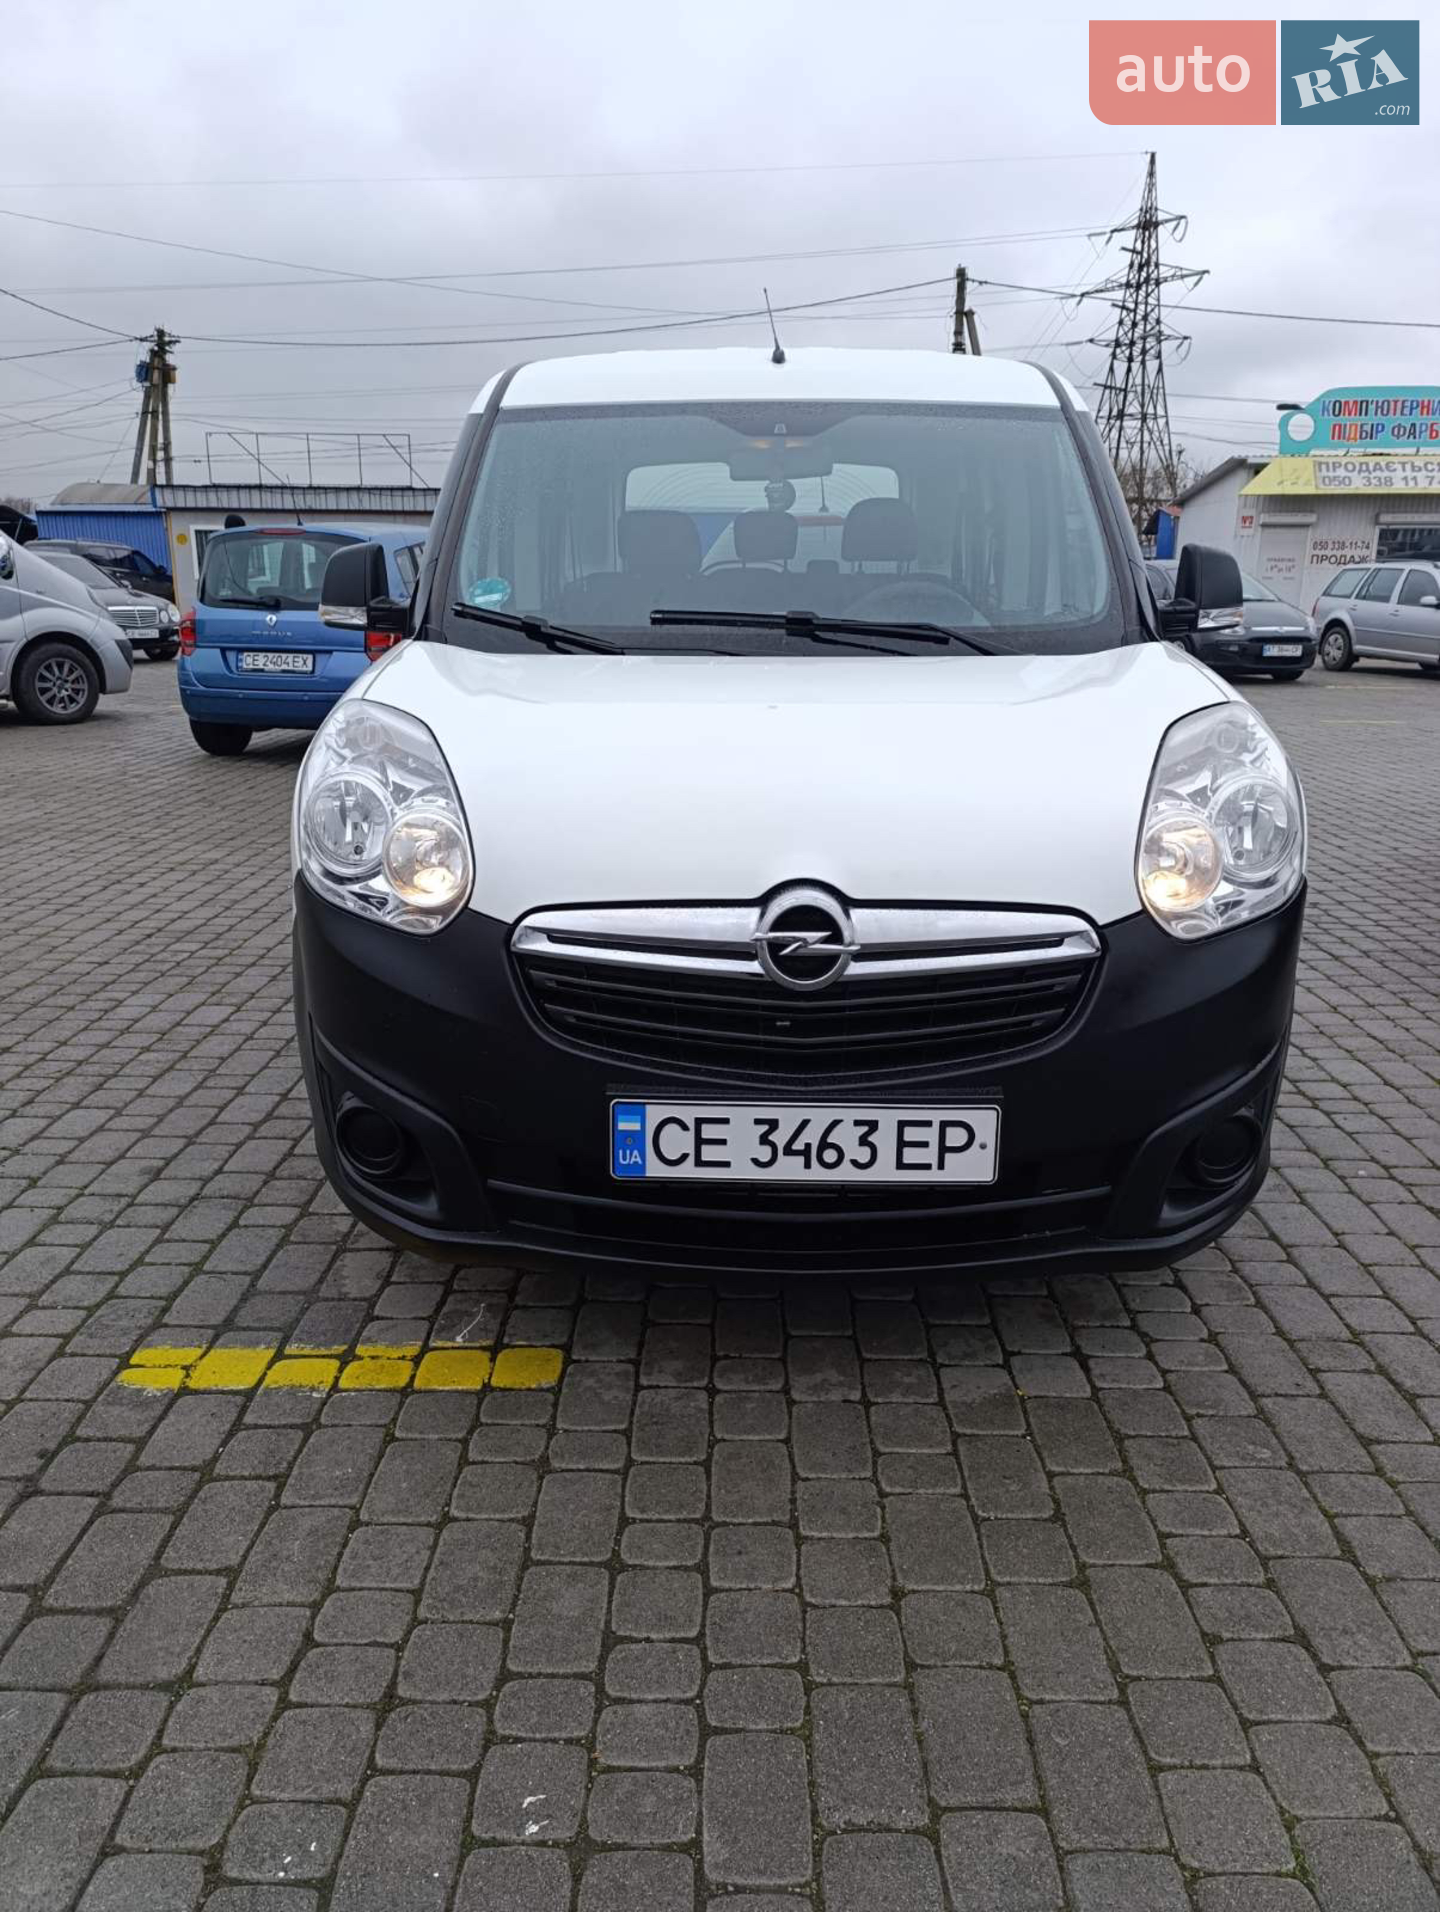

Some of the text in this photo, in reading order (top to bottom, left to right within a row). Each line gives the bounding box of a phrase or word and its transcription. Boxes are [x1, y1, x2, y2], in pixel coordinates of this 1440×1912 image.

[1331, 422, 1386, 442] ПІДБІР
[1322, 475, 1440, 487] 050 338 11 7
[1313, 540, 1329, 551] 050
[1310, 554, 1370, 566] ПРОДАЖ
[244, 654, 309, 669] CE 2404 EX
[652, 1116, 976, 1171] CE 3463 EP
[618, 1150, 642, 1164] UA
